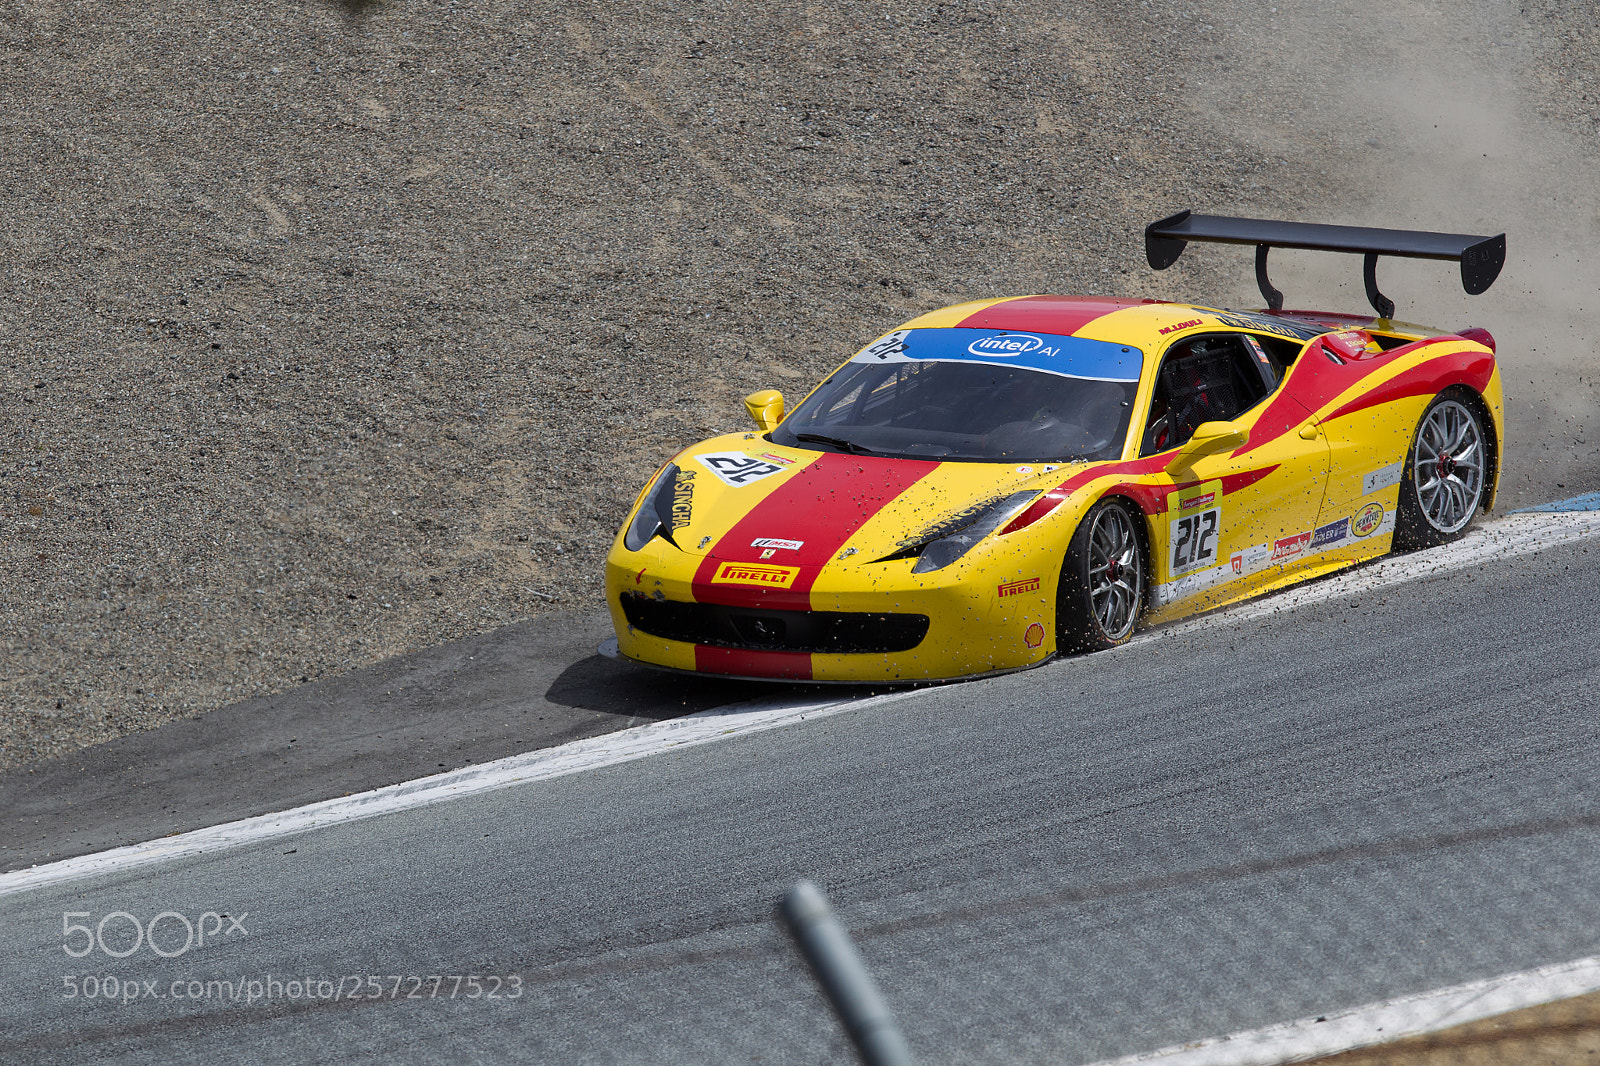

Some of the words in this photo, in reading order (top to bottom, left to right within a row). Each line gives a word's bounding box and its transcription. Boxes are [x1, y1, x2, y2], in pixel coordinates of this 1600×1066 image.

[979, 337, 1032, 352] intel
[1037, 346, 1061, 357] AI
[704, 457, 782, 483] 212
[671, 482, 695, 530] SINGHA
[1173, 510, 1217, 568] 212
[720, 565, 791, 583] PIRELLI
[997, 577, 1040, 598] PIRELLI
